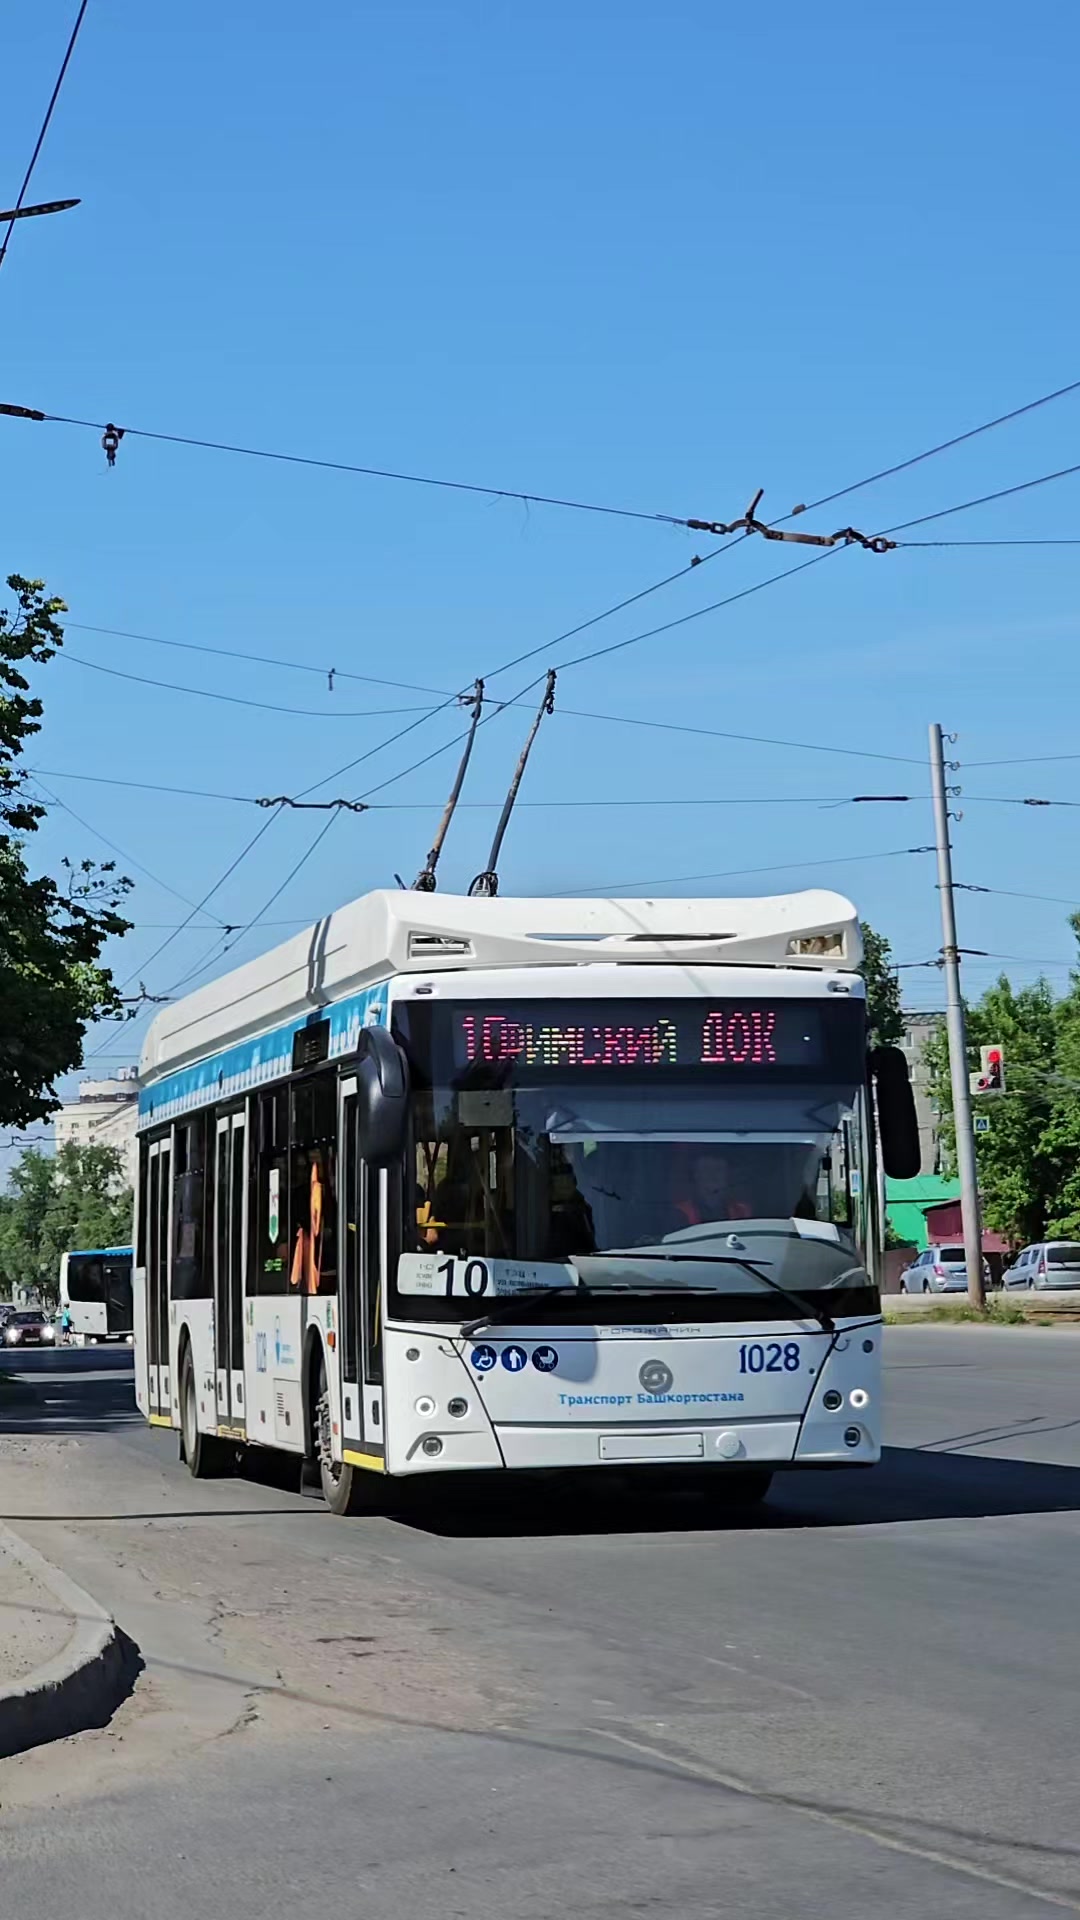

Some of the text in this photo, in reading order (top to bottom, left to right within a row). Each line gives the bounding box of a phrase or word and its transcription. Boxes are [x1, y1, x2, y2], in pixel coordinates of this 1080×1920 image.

[700, 1011, 776, 1062] ДОК
[437, 1258, 490, 1297] 10
[739, 1343, 801, 1373] 1028
[559, 1391, 745, 1406] Транспорт Башкортостана
